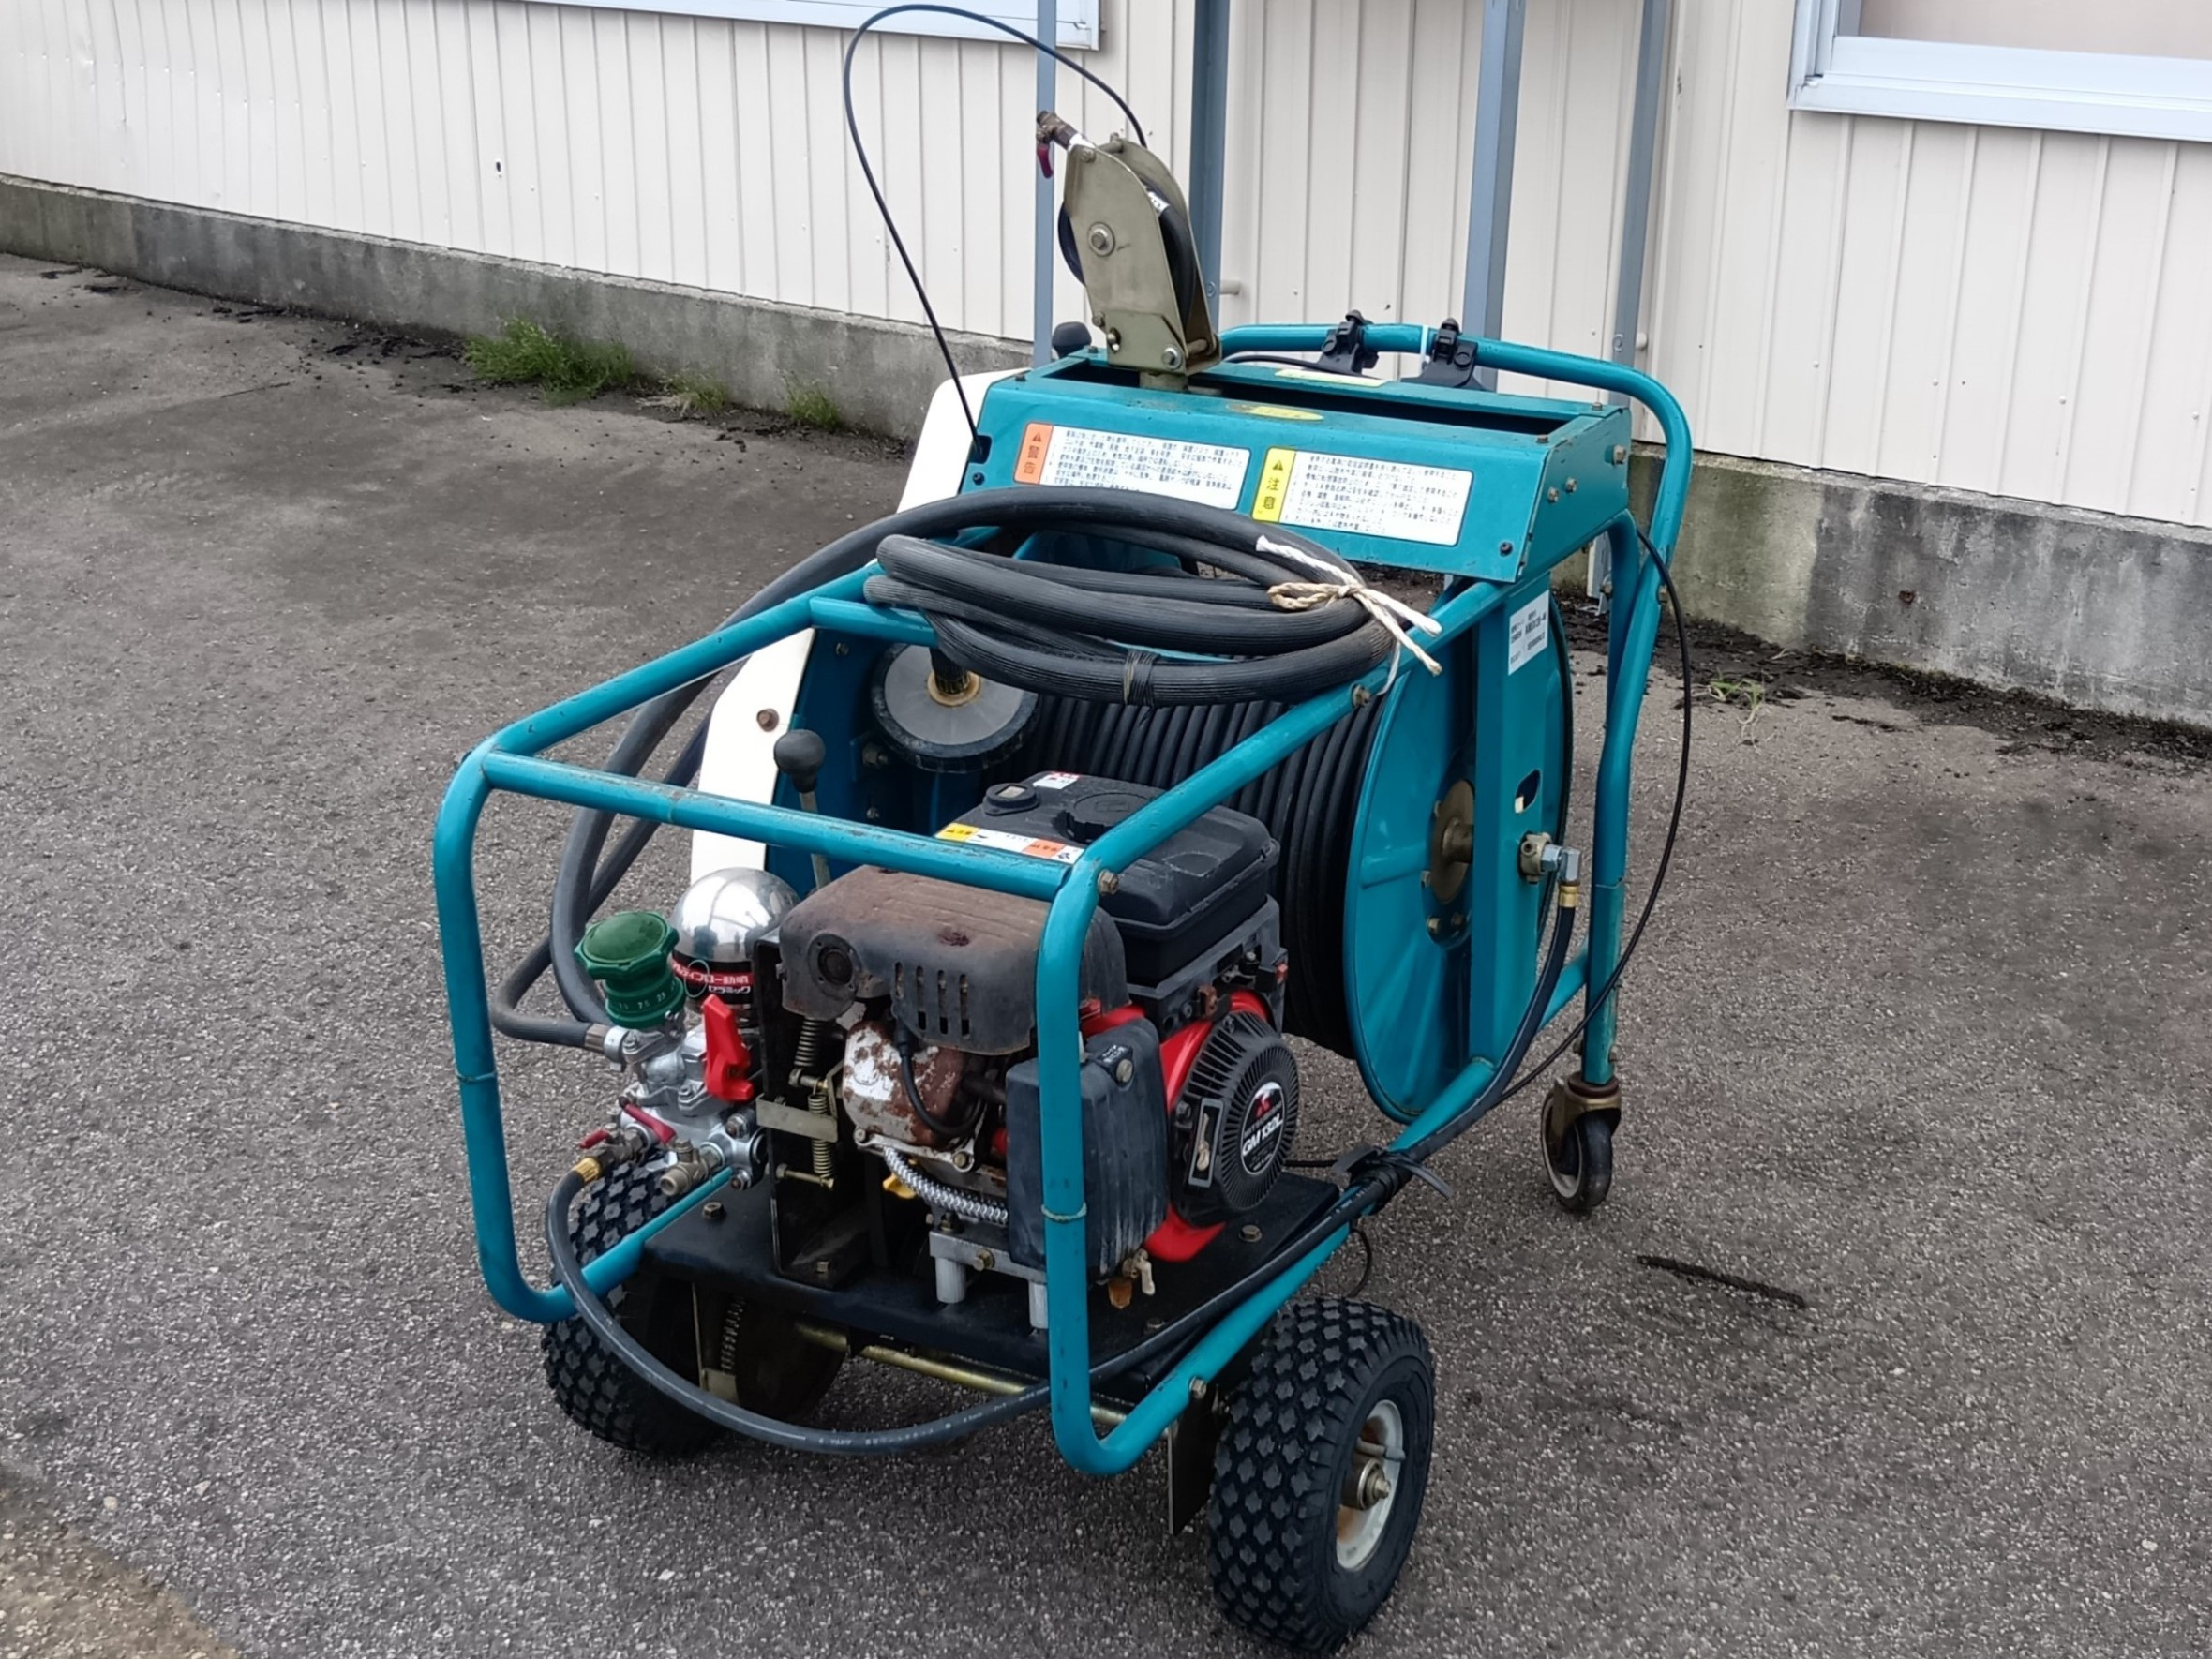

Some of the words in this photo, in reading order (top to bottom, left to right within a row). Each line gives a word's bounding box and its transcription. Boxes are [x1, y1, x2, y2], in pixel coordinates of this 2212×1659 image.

[1263, 477, 1279, 509] 注意
[708, 985, 751, 994] セラミック
